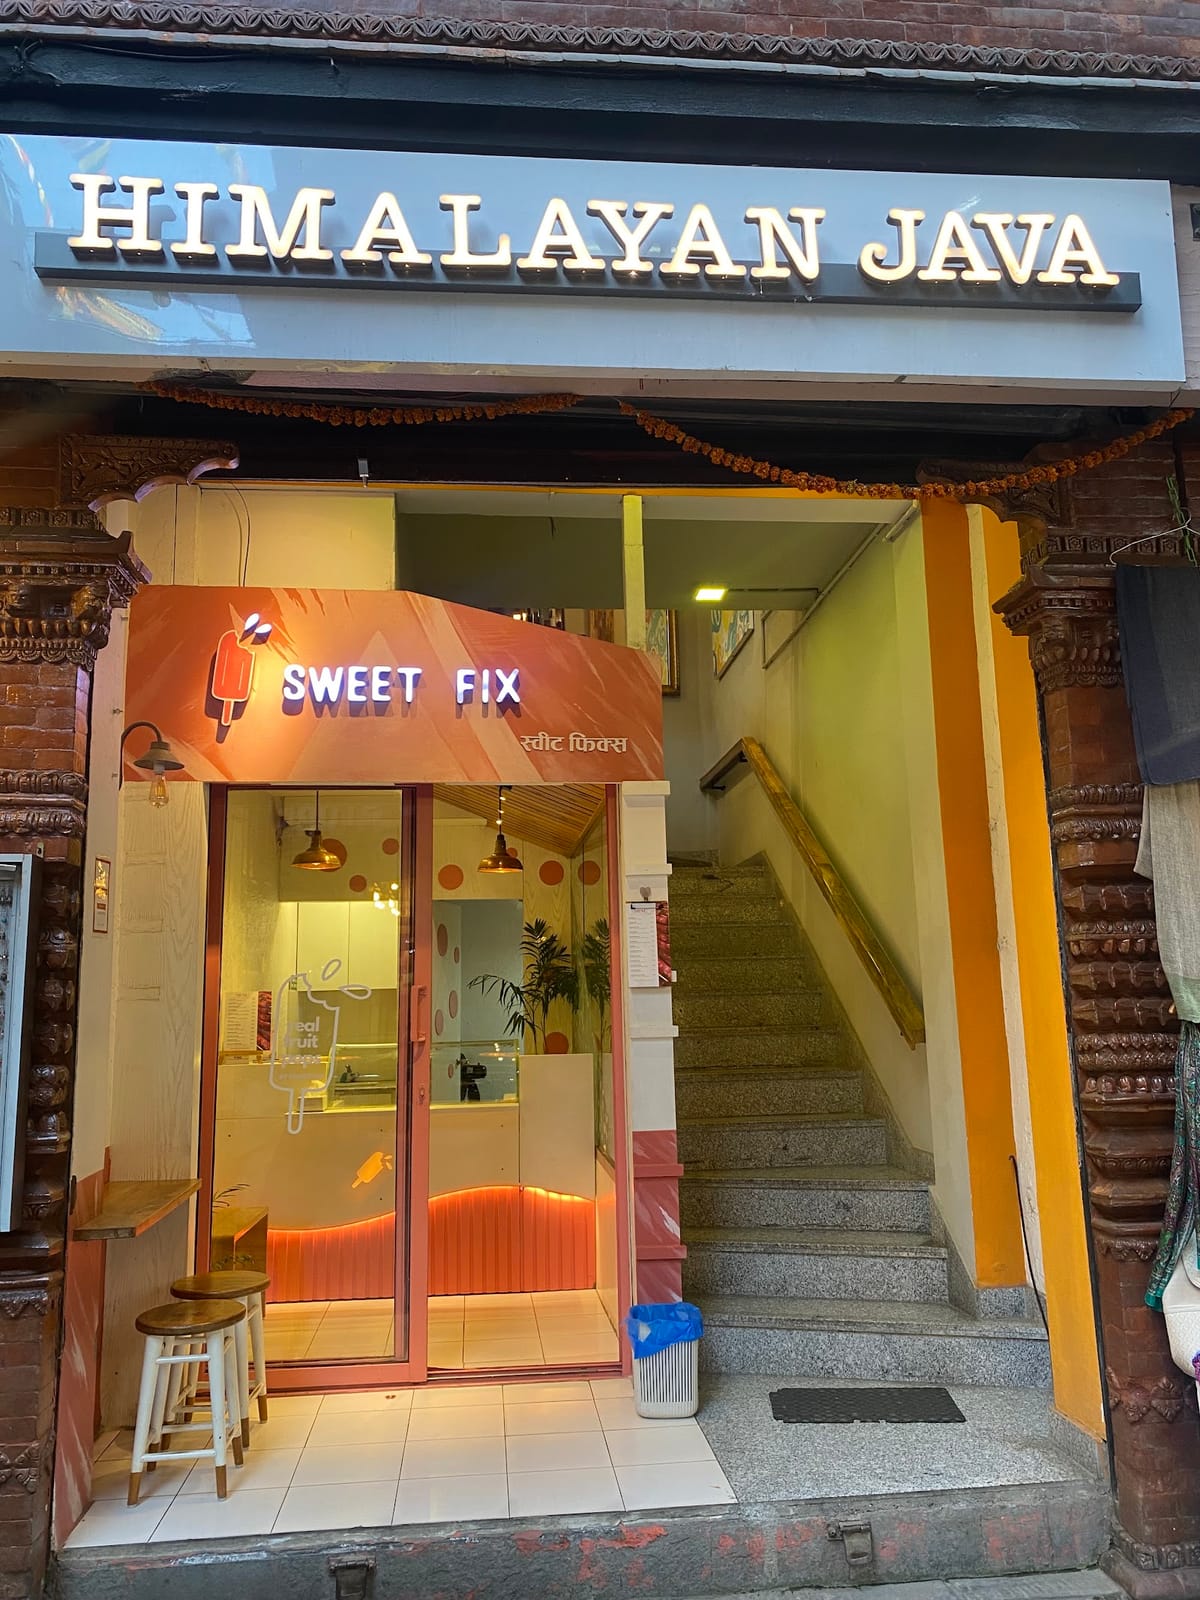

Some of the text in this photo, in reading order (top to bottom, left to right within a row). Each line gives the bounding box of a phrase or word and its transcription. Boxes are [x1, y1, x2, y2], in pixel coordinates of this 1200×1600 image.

[67, 173, 1121, 287] HIMALAYAN JAVA
[283, 663, 521, 704] SWEET FIX
[520, 731, 629, 753] स्वीट फिक्स
